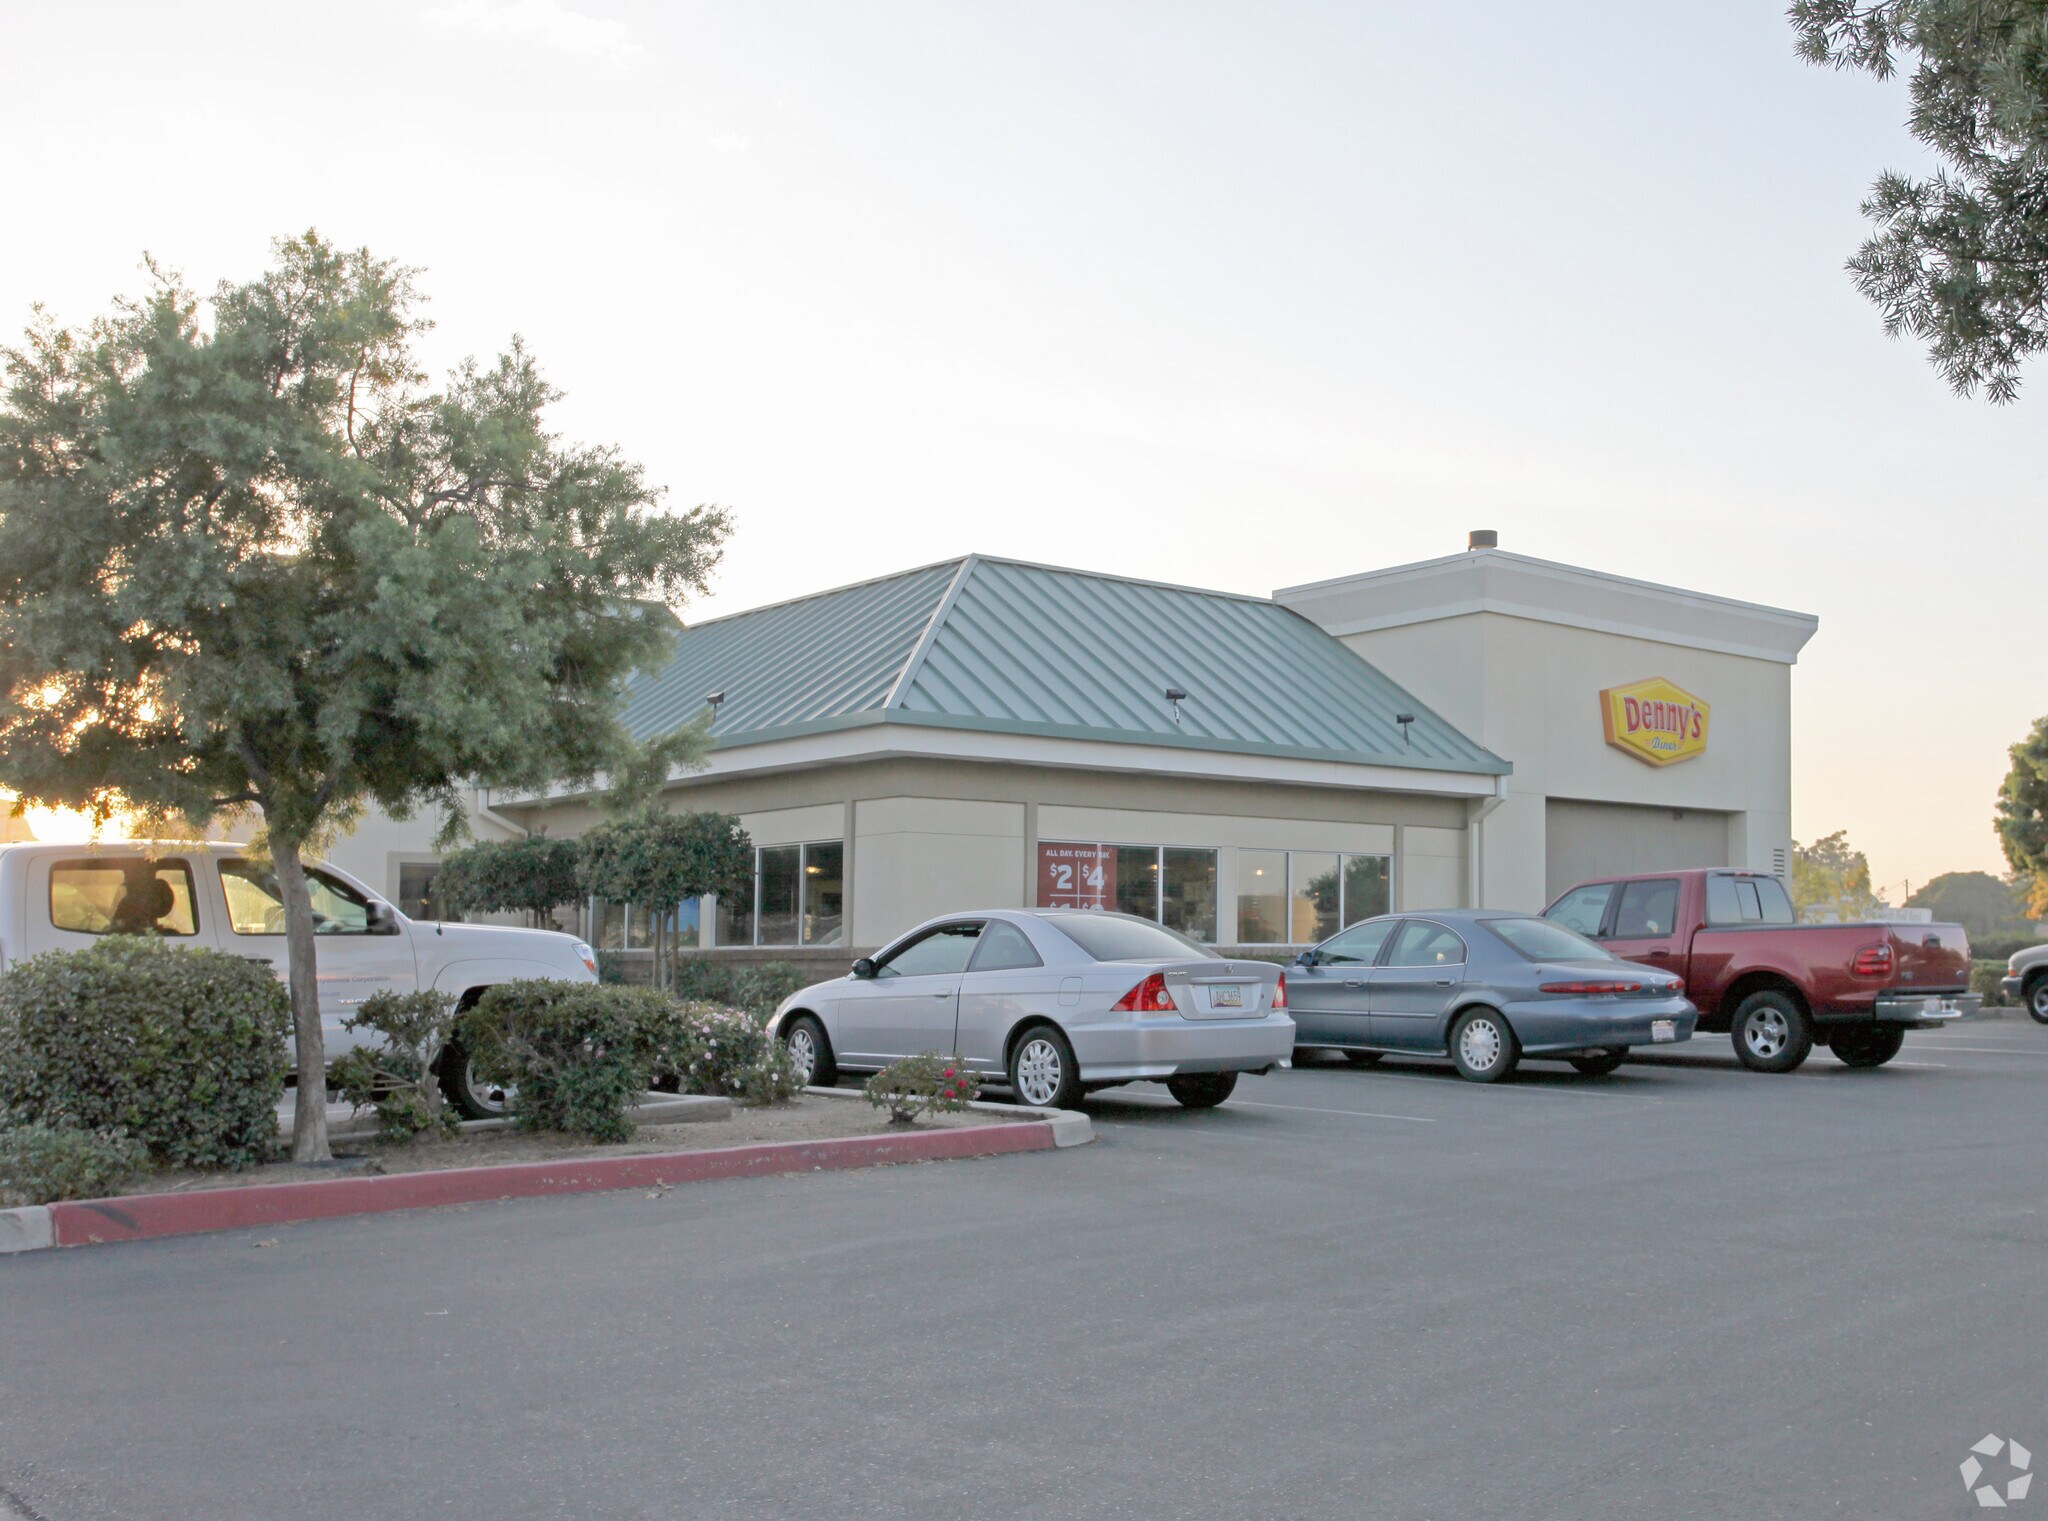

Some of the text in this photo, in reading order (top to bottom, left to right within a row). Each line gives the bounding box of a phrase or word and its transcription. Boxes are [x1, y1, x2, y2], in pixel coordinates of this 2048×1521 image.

[1623, 696, 1703, 740] Denny's
[1652, 736, 1677, 751] Diner
[1046, 849, 1058, 857] ALL
[1074, 850, 1097, 858] EVERY
[1050, 863, 1073, 890] $2
[1082, 863, 1105, 890] $4
